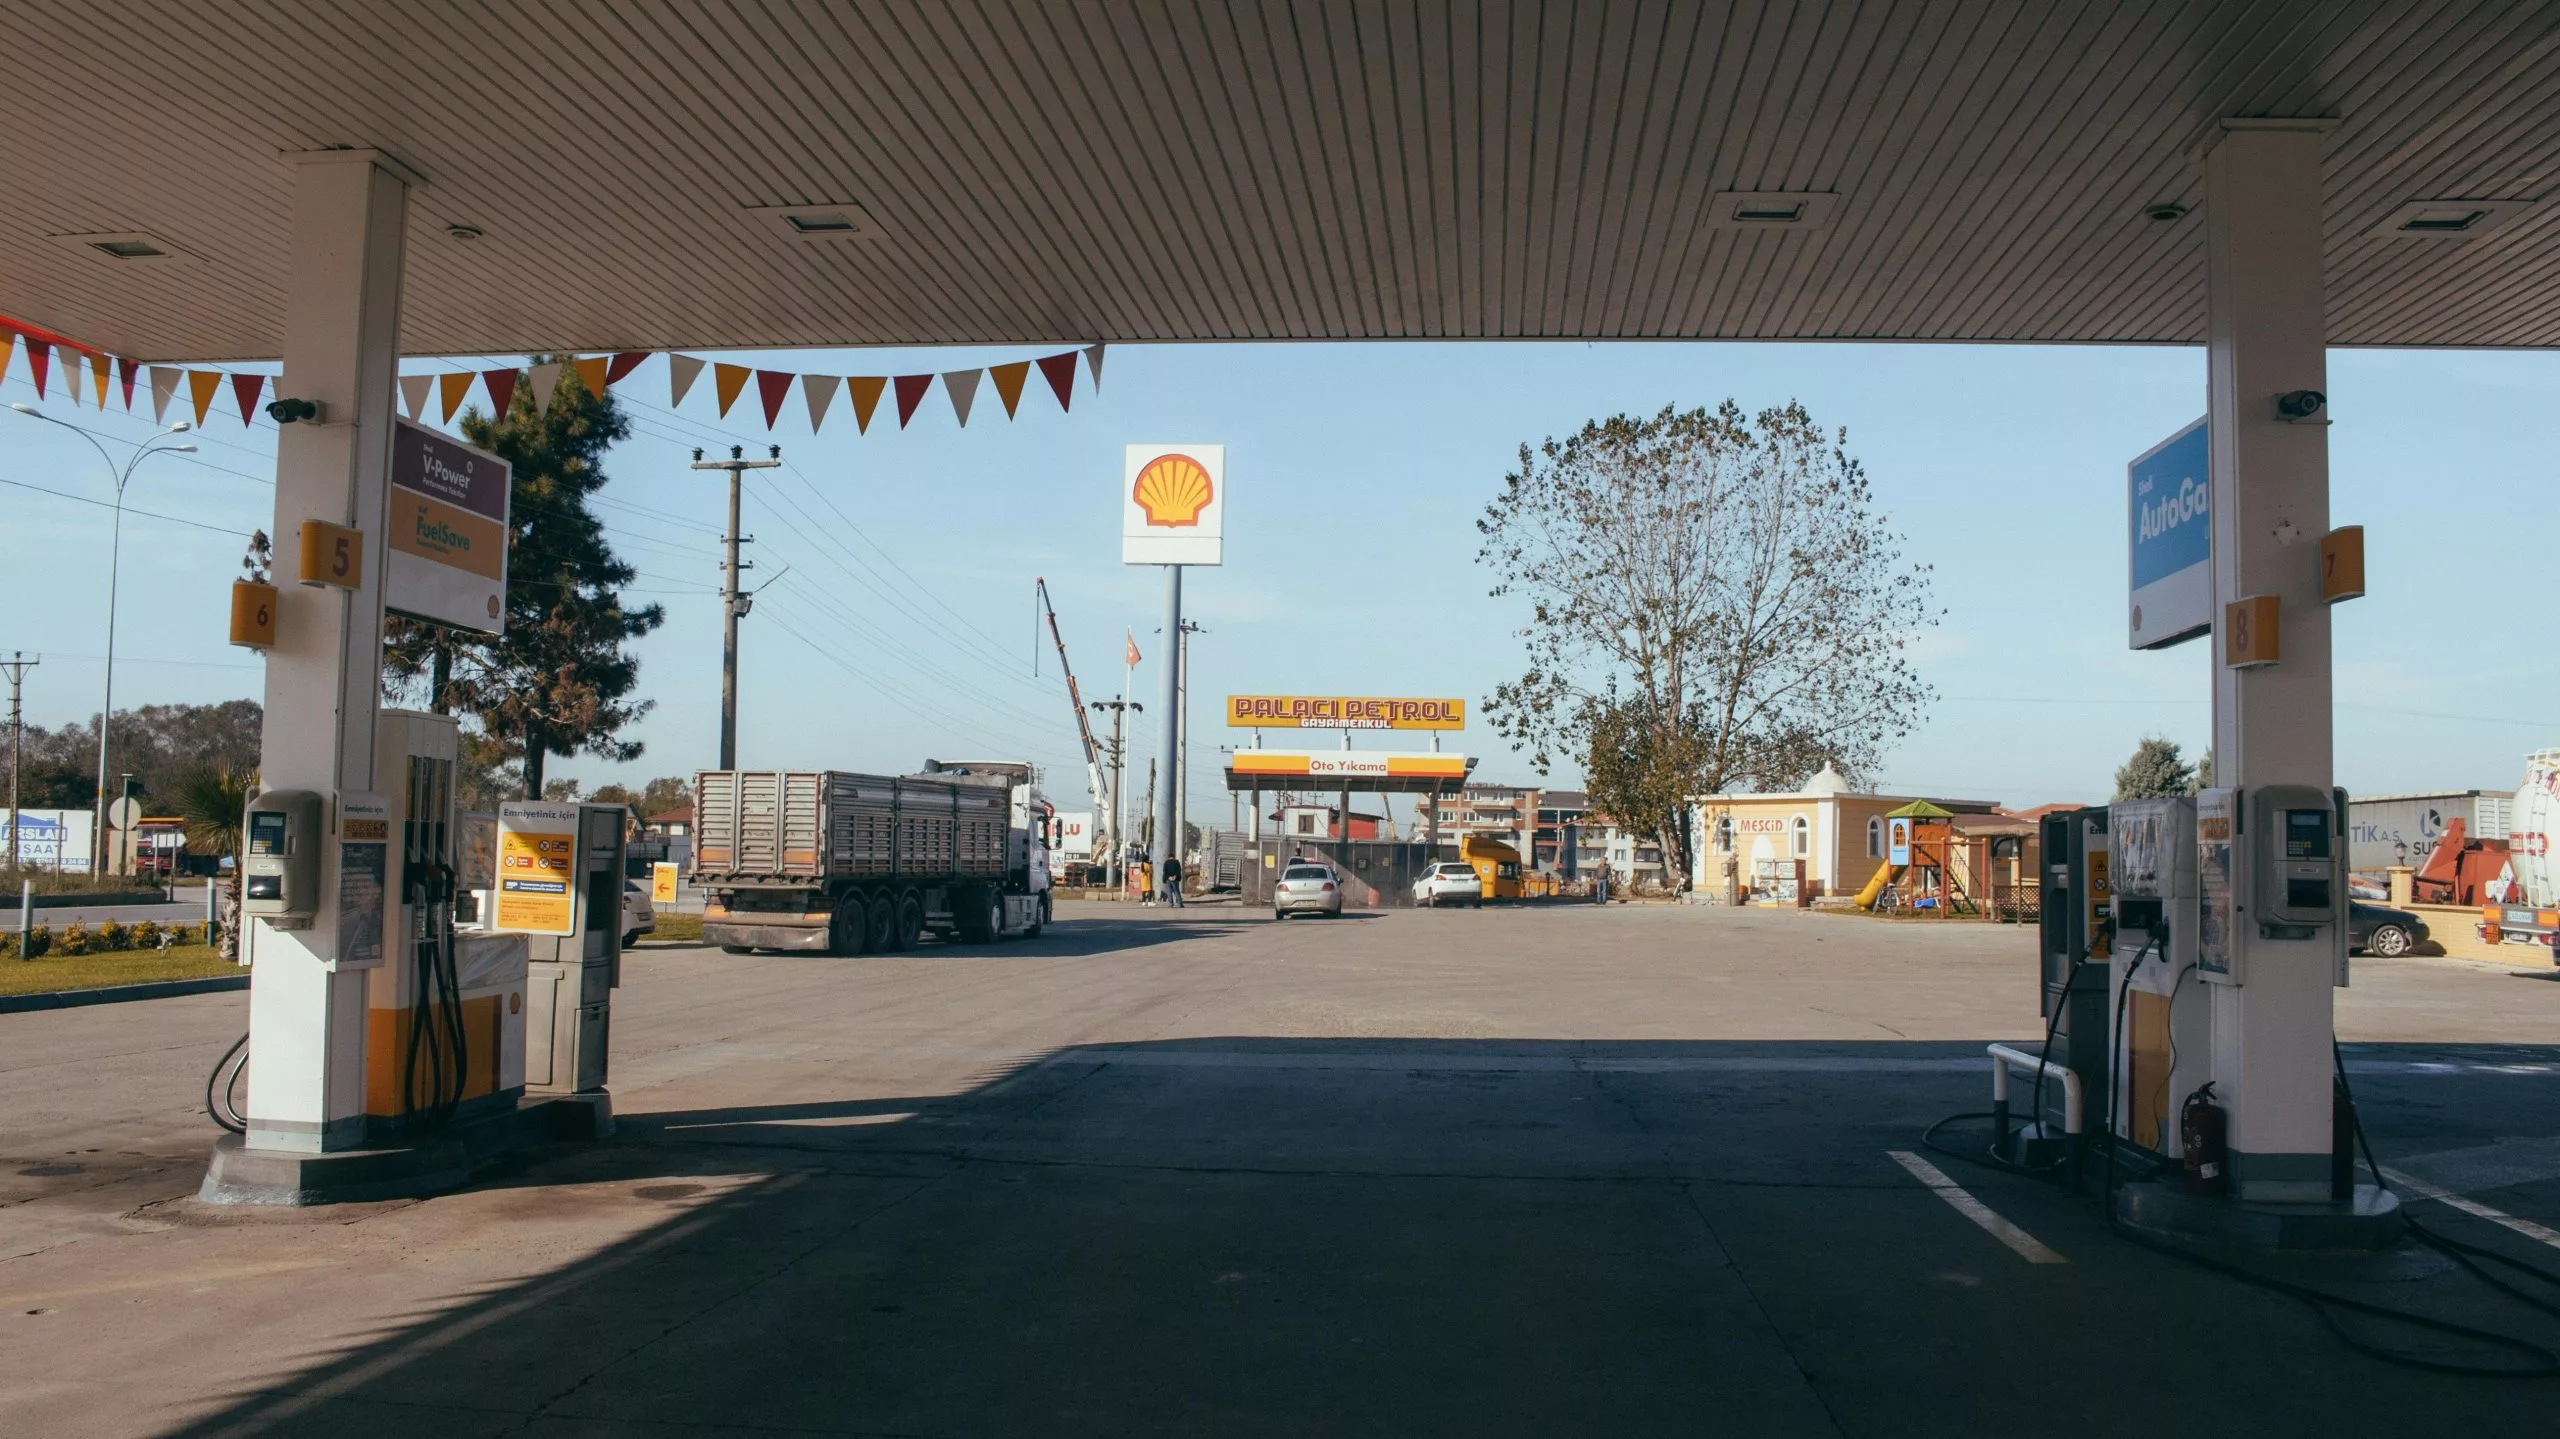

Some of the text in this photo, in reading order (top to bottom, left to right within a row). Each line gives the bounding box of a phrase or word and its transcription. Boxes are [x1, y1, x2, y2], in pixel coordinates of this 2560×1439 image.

[423, 454, 471, 489] V-Power
[2139, 476, 2209, 545] AutoGa
[416, 515, 470, 551] FuelSave
[332, 537, 350, 577] 5
[2327, 553, 2336, 578] 7
[257, 604, 269, 626] 6
[2236, 608, 2249, 653] 8
[1235, 698, 1460, 721] PALACI PETROL
[1311, 760, 1334, 771] Oto
[503, 808, 575, 821] Emniyetiniz için
